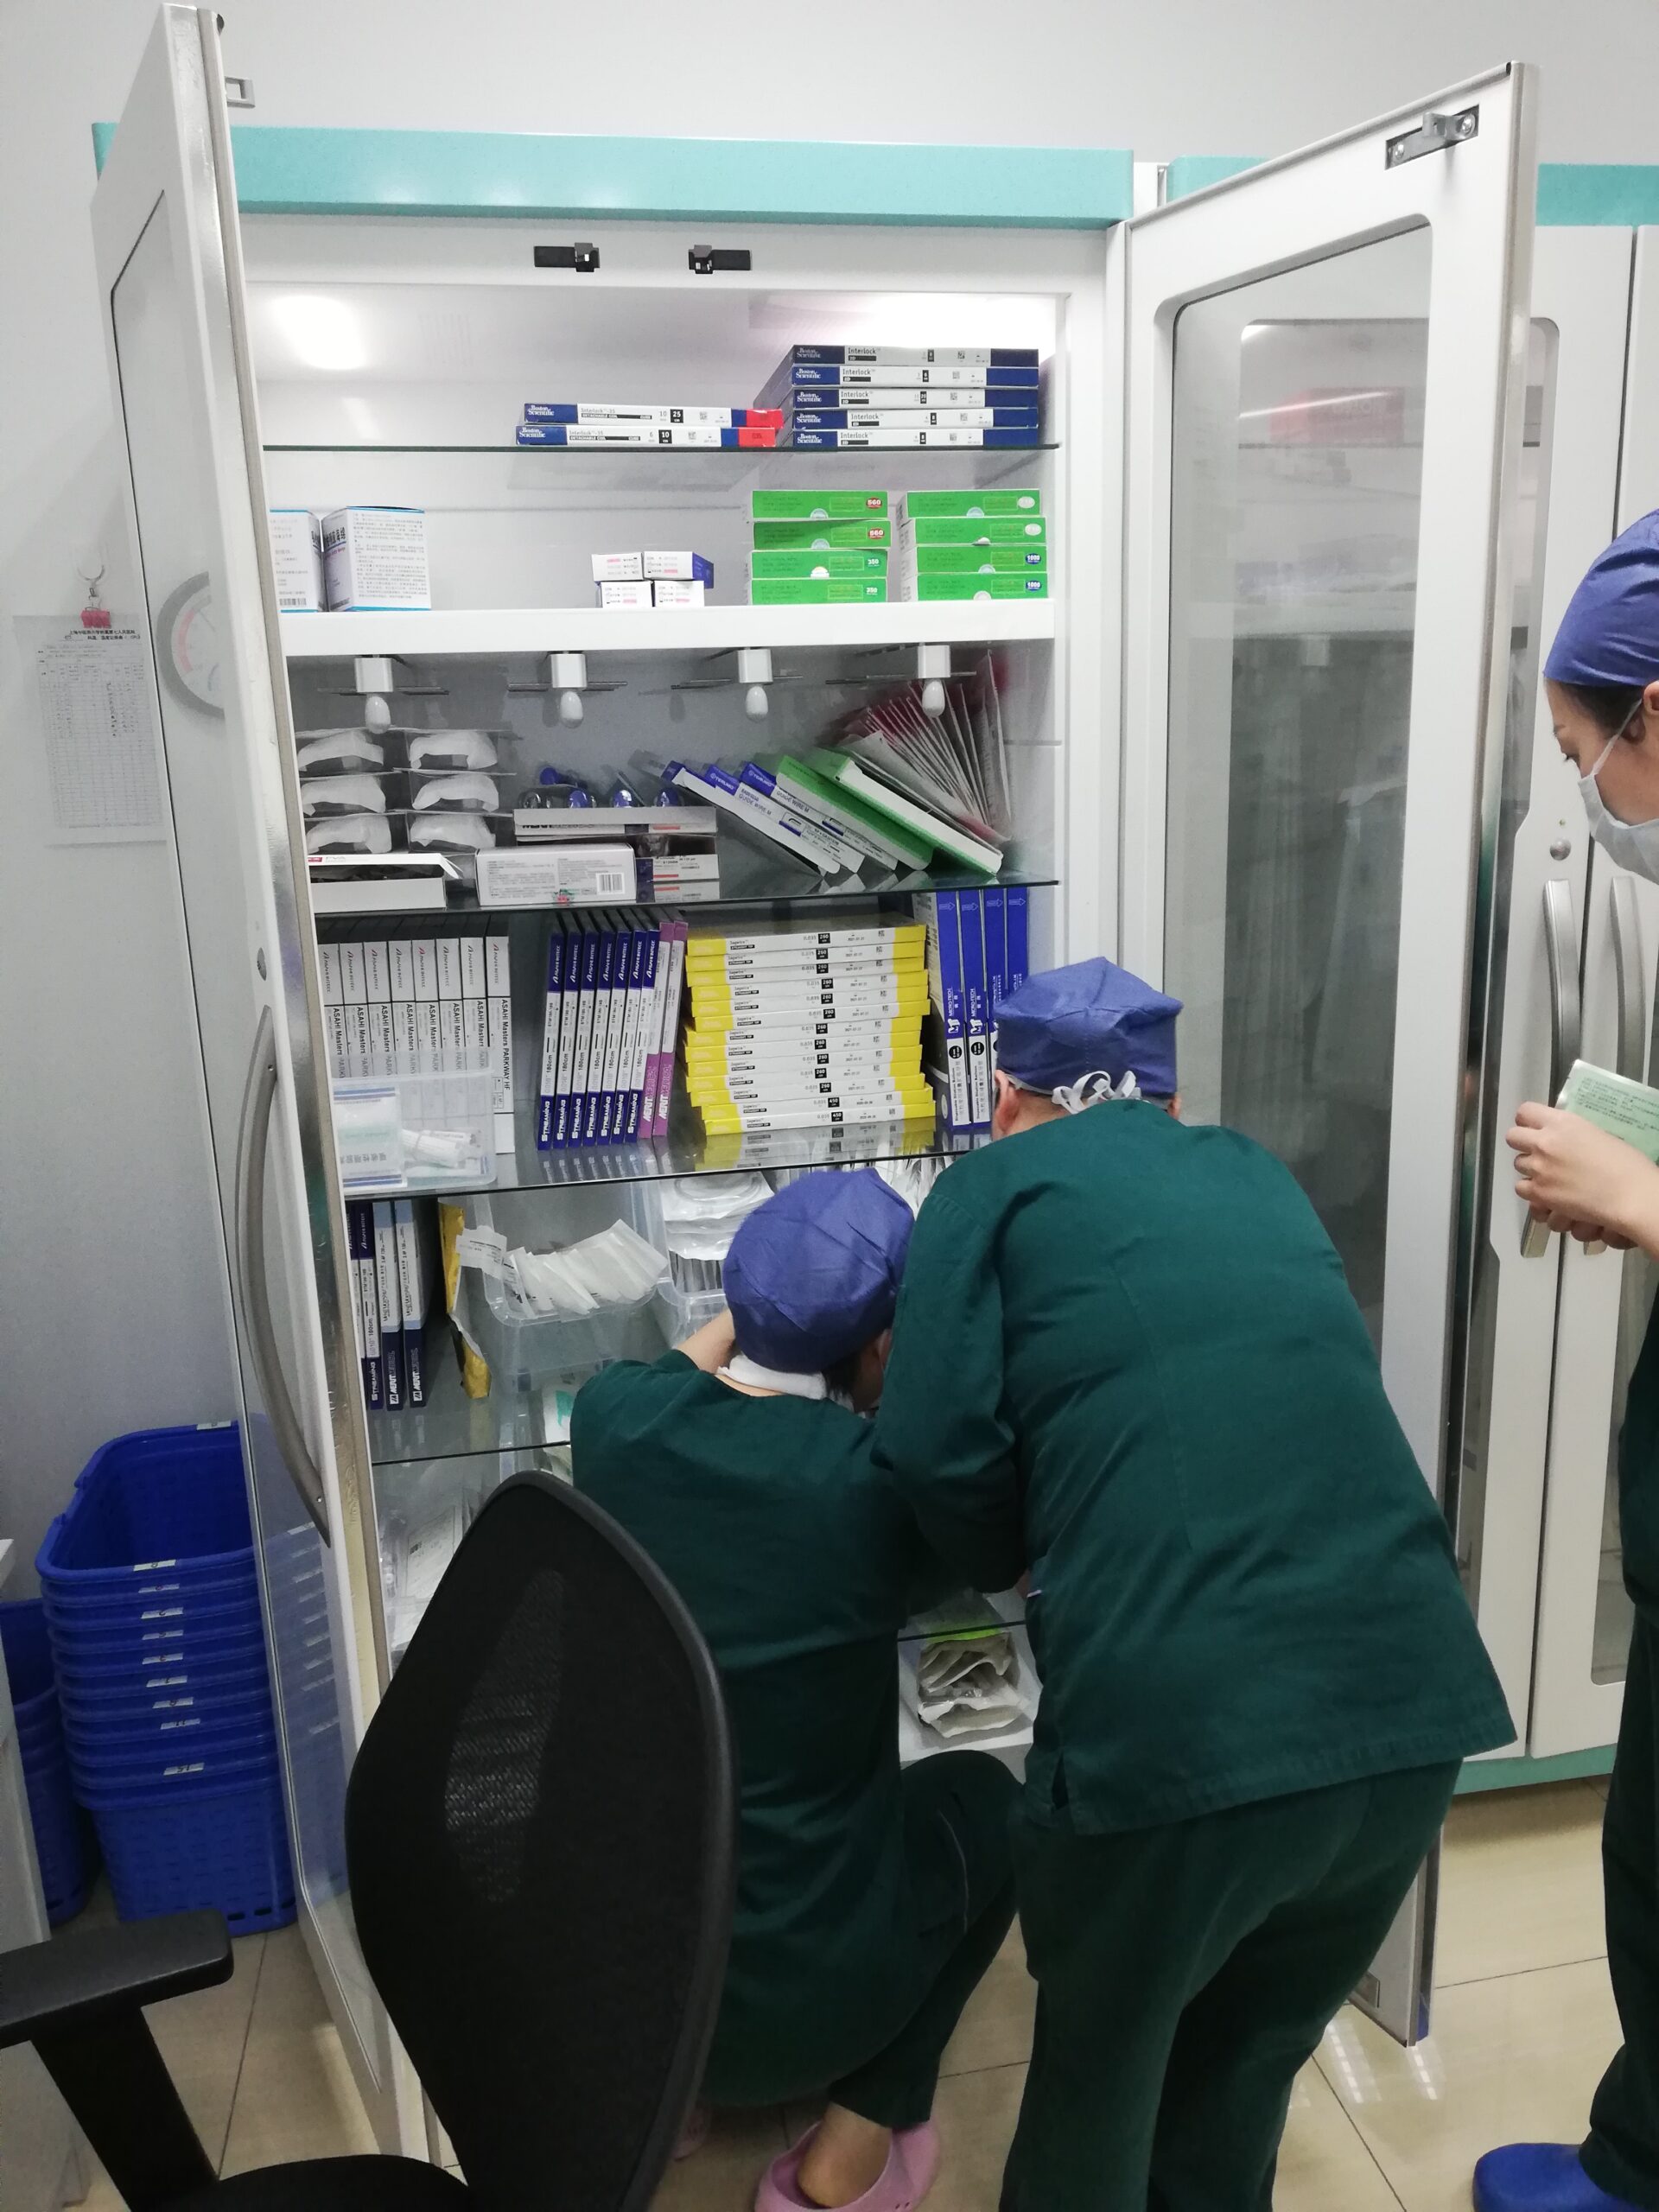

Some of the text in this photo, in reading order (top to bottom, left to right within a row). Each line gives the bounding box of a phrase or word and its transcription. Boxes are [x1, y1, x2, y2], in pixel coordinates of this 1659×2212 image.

[505, 1081, 510, 1090] HF
[643, 1096, 653, 1122] MERIT
[658, 1094, 669, 1120] MERIT
